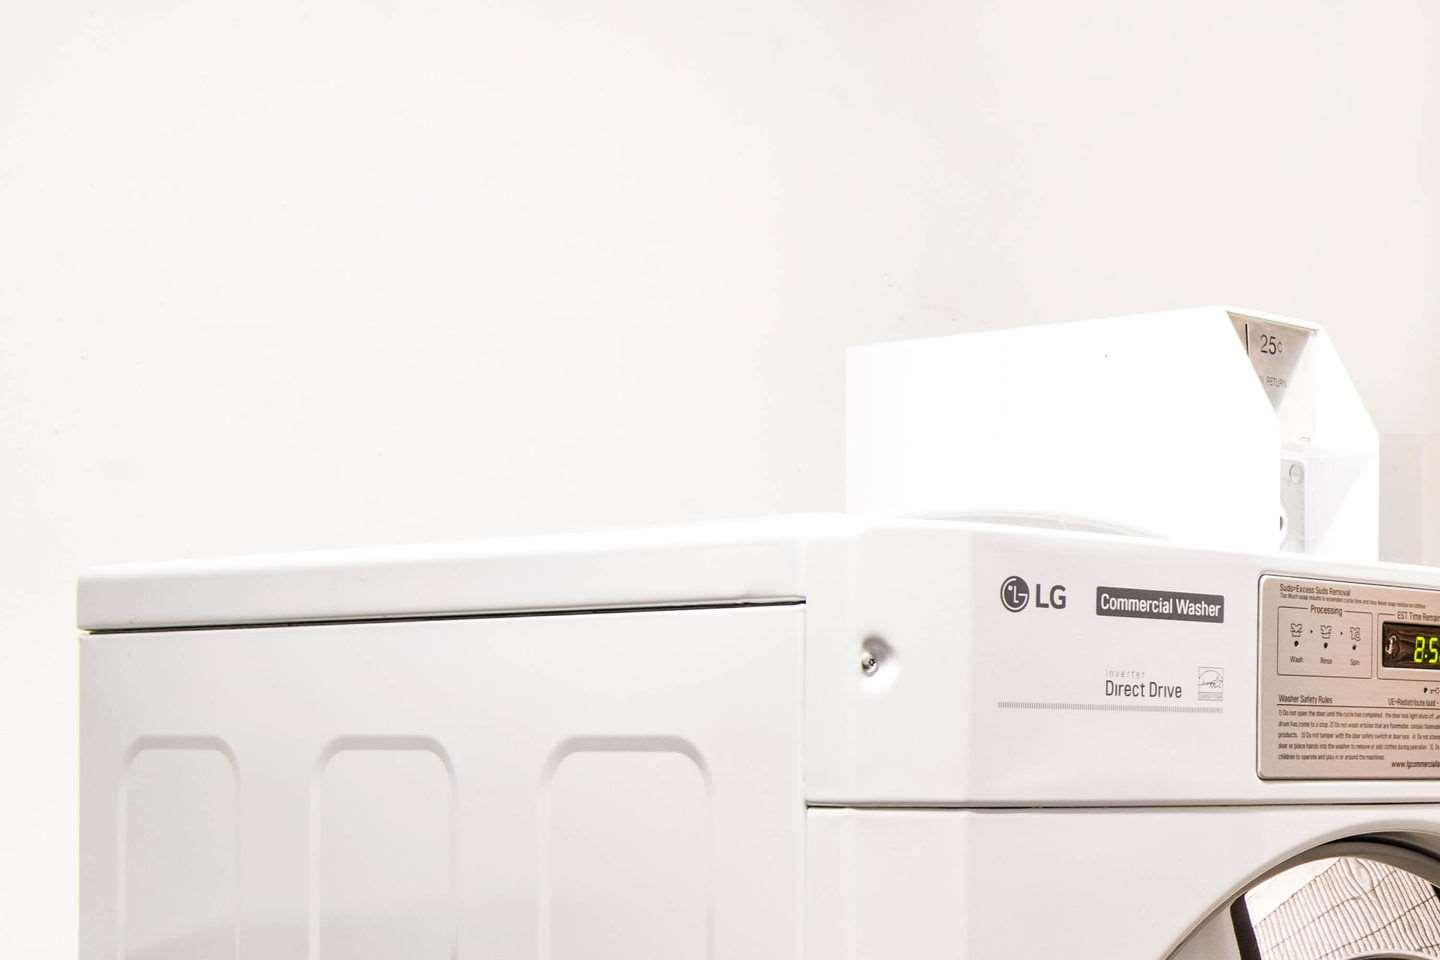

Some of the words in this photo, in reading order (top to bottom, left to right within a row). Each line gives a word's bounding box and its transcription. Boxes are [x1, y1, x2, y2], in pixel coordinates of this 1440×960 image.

[1036, 584, 1067, 609] LG
[1100, 593, 1173, 614] Commercial
[1176, 599, 1222, 617] Washer
[1311, 604, 1343, 617] Processing
[1409, 613, 1422, 621] Time
[1290, 656, 1304, 664] Wash
[1105, 680, 1146, 697] Direct
[1149, 681, 1182, 698] Drive
[1278, 695, 1299, 703] Washer
[1300, 695, 1317, 704] Safety
[1318, 696, 1334, 704] Rules
